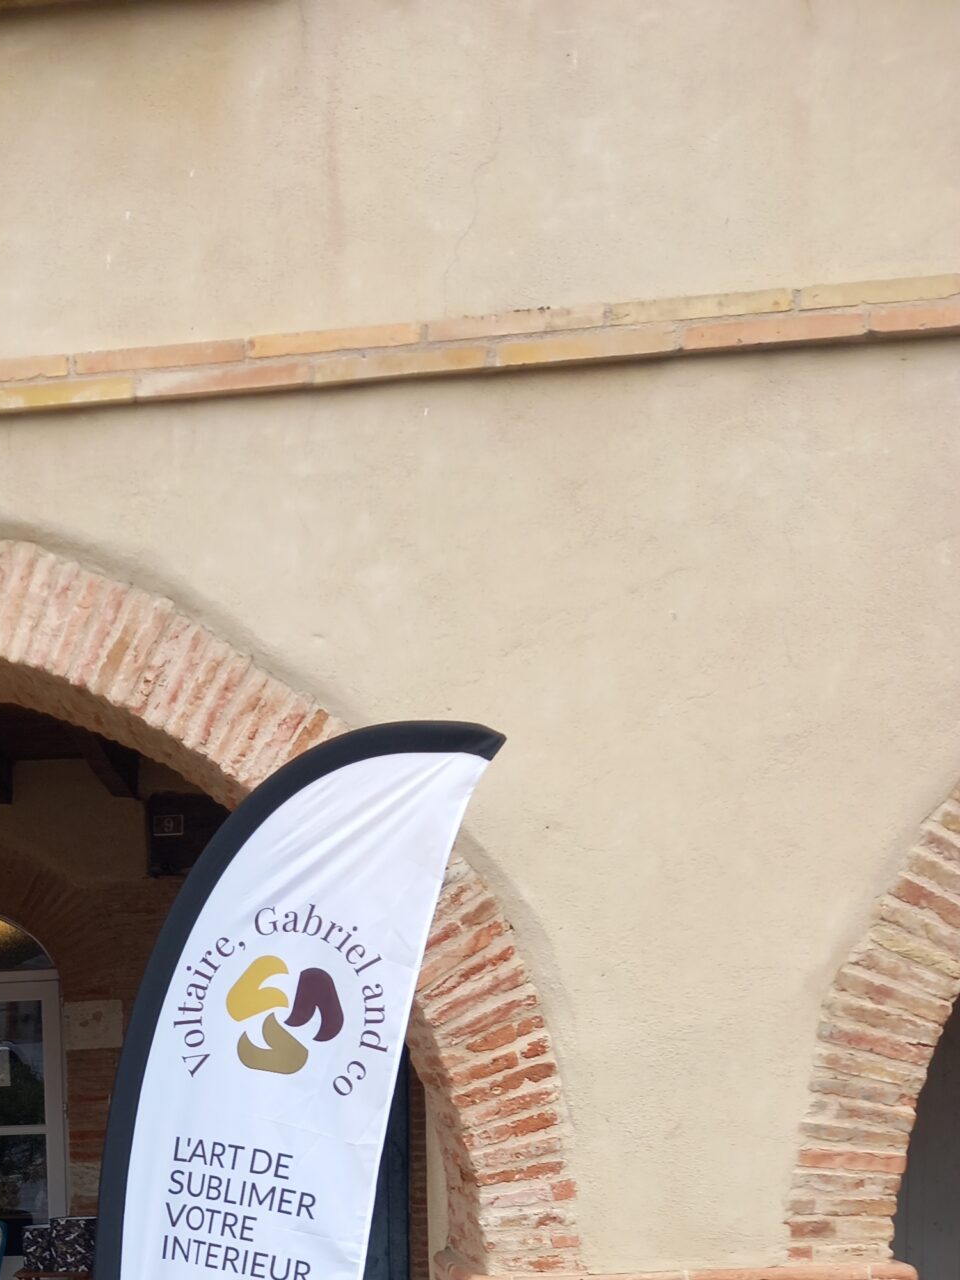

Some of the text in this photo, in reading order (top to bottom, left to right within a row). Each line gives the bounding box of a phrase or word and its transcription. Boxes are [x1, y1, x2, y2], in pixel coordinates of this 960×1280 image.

[163, 817, 174, 833] 9
[173, 903, 389, 1097] Voltaire, Gabriel and co
[172, 1135, 294, 1181] L'ART DE
[167, 1168, 317, 1220] SUBLIMER
[164, 1201, 258, 1243] VOTRE
